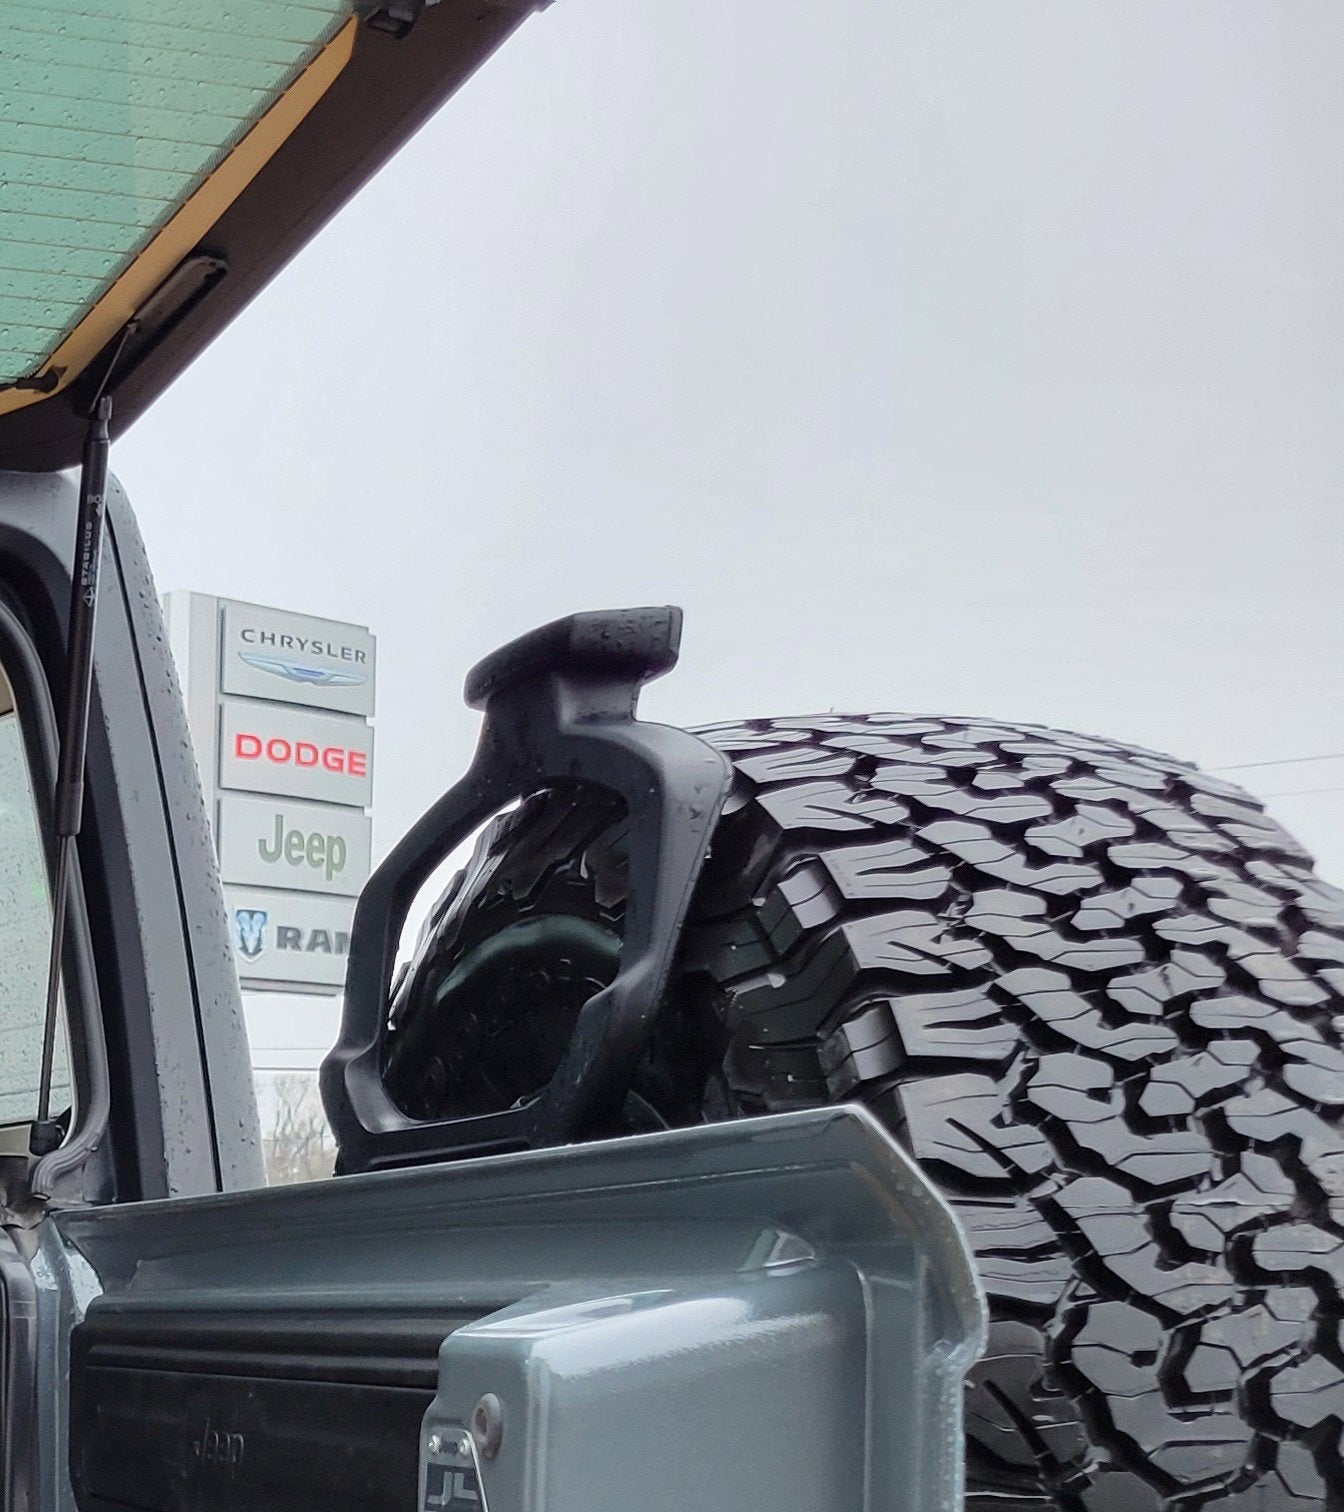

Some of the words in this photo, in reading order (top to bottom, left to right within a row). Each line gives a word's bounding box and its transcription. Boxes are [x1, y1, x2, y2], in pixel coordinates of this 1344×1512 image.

[81, 521, 93, 587] STABILUS
[241, 629, 367, 665] CHRYSLER
[235, 733, 367, 777] DODGE
[258, 814, 346, 881] Jeep
[427, 1471, 478, 1506] JL
